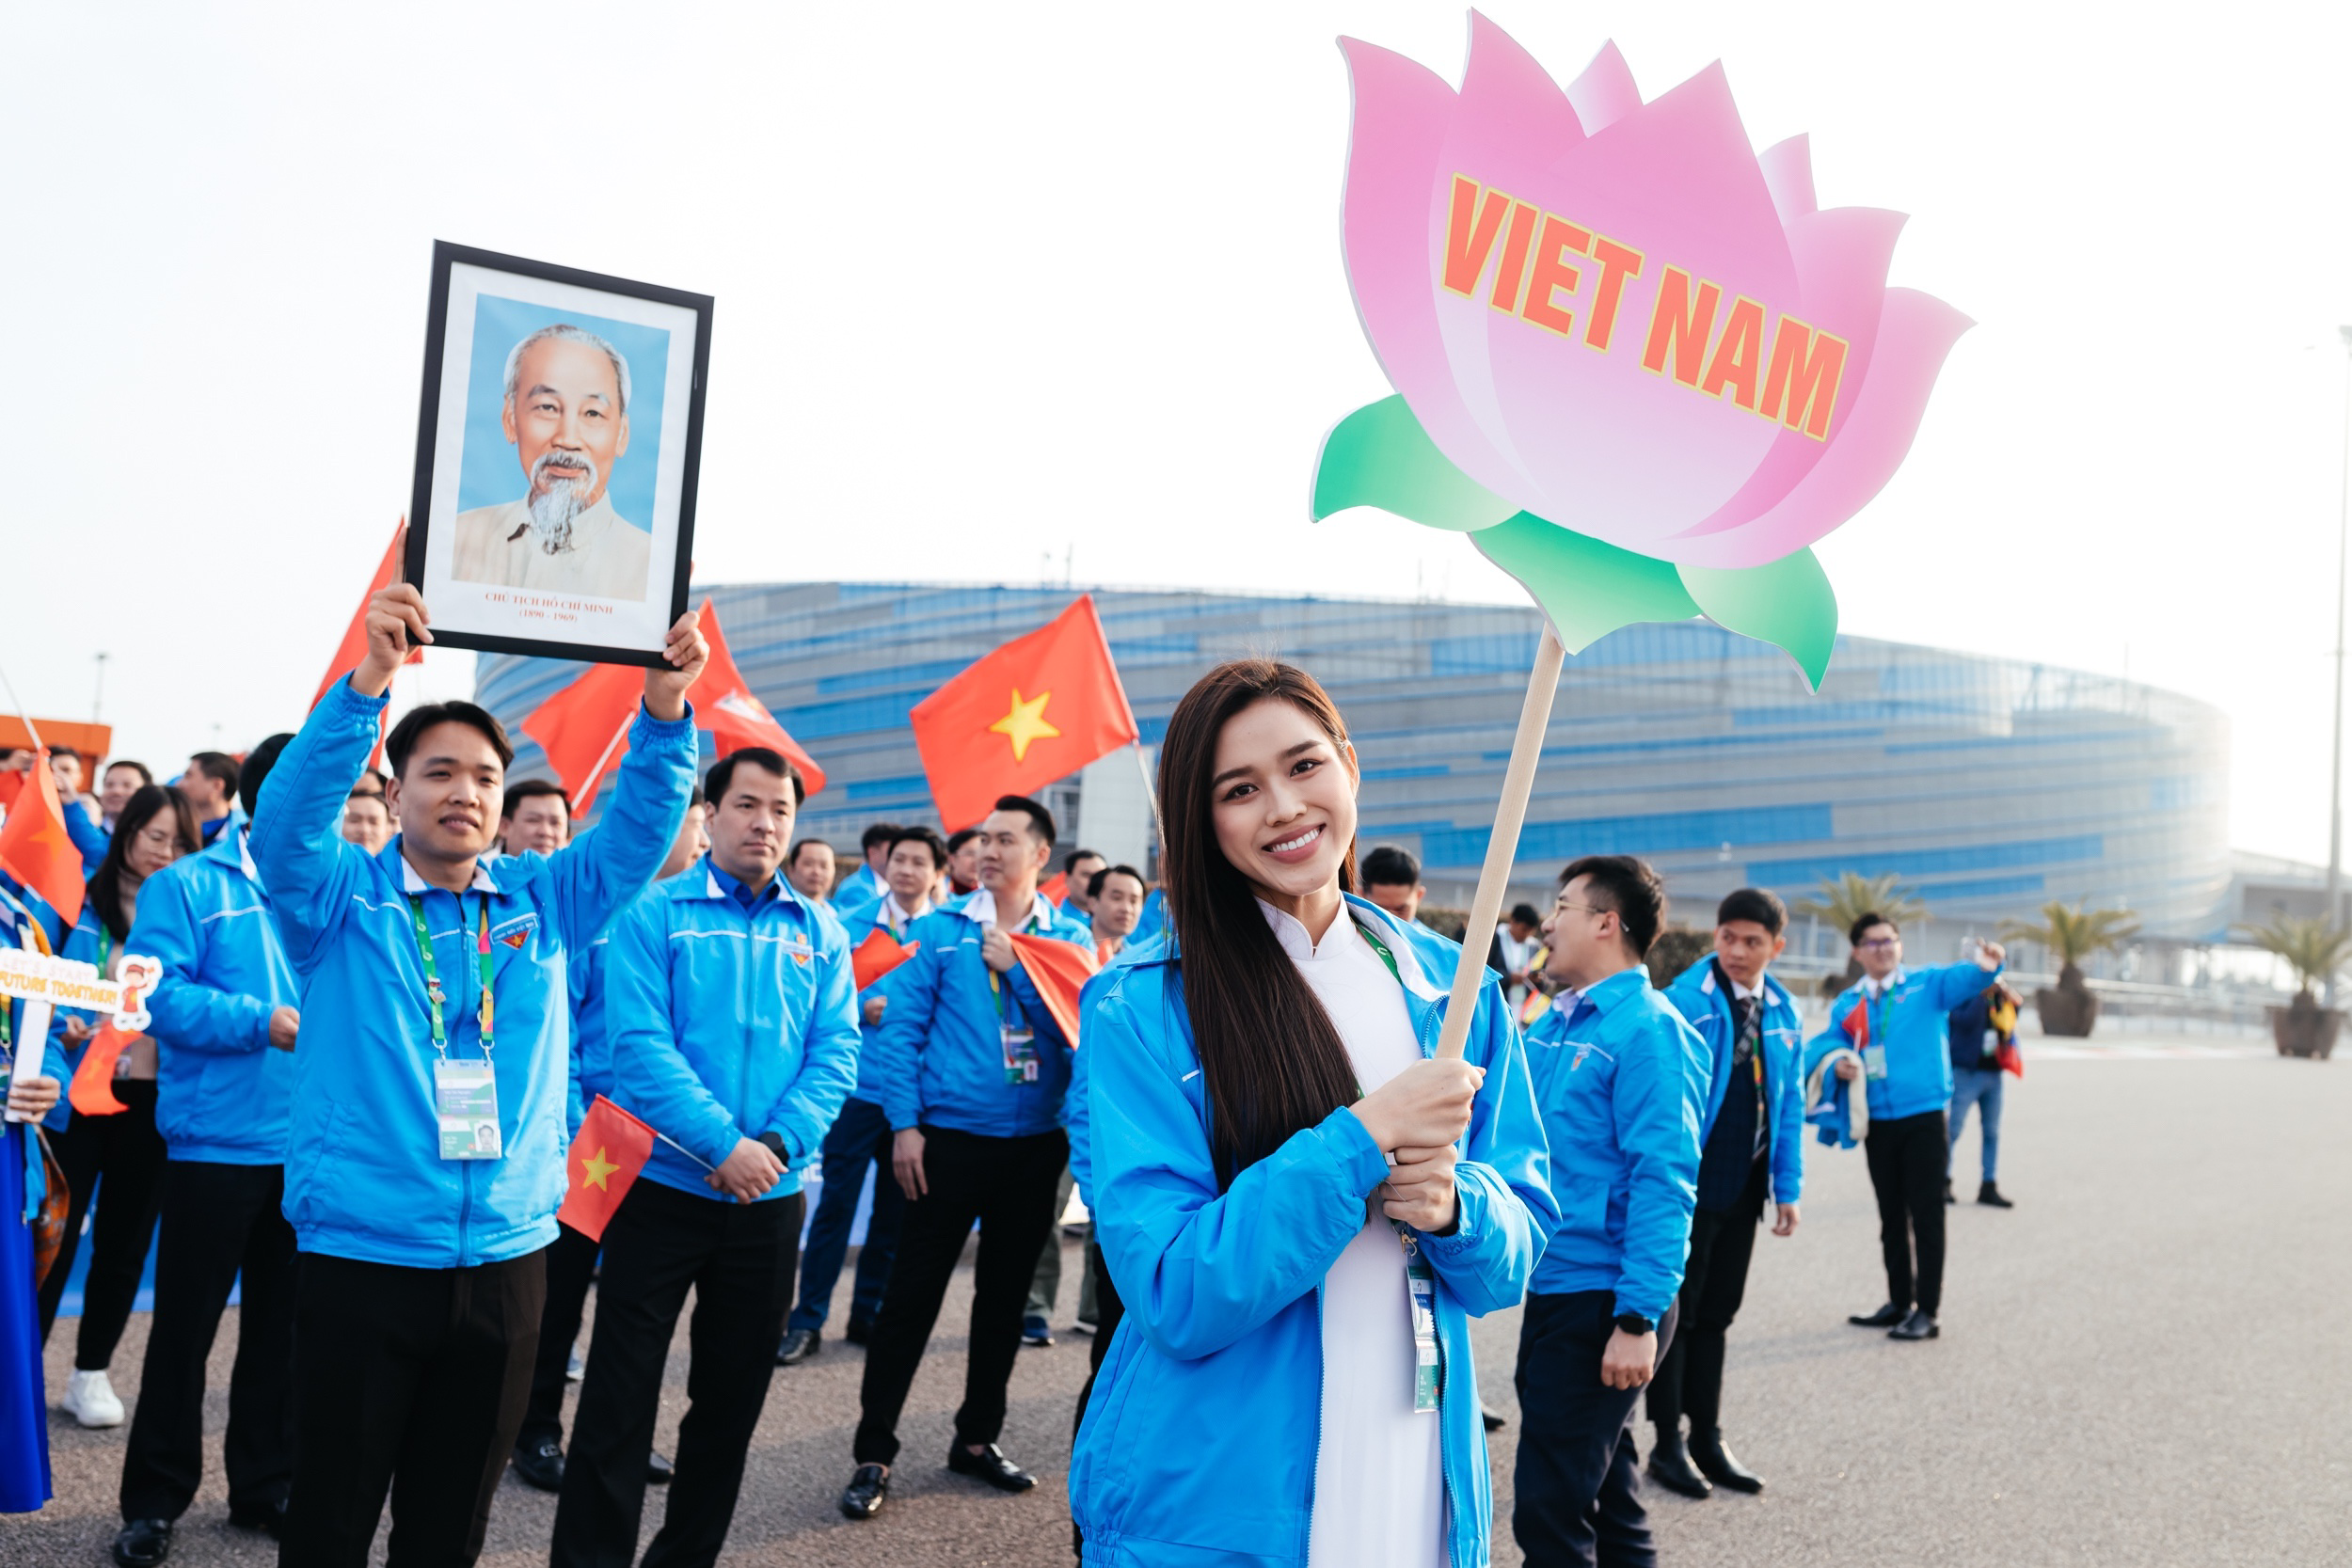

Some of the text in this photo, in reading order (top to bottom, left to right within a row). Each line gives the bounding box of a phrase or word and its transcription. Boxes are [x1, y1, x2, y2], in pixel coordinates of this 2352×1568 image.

[1440, 171, 1850, 442] VIET NAM
[584, 603, 613, 614] MINH
